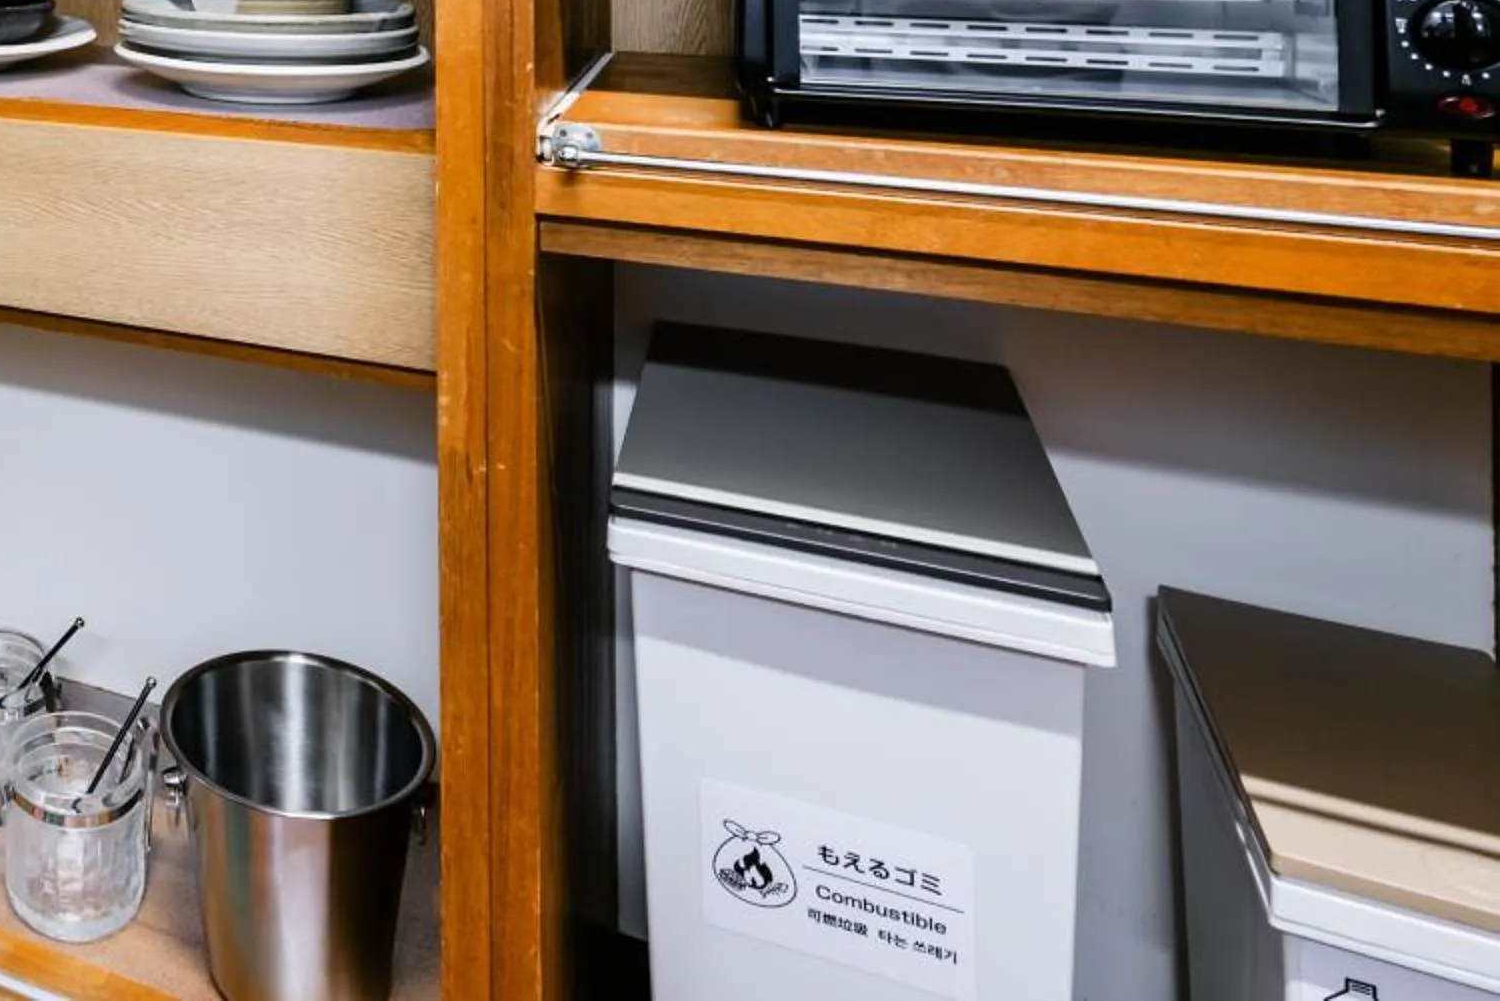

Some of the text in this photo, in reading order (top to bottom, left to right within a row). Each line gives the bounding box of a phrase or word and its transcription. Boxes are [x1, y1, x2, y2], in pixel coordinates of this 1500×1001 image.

[817, 844, 943, 897] もえるゴミ
[807, 907, 869, 939] 可燃垃圾
[814, 884, 947, 935] Combustible
[878, 928, 909, 950] 타는
